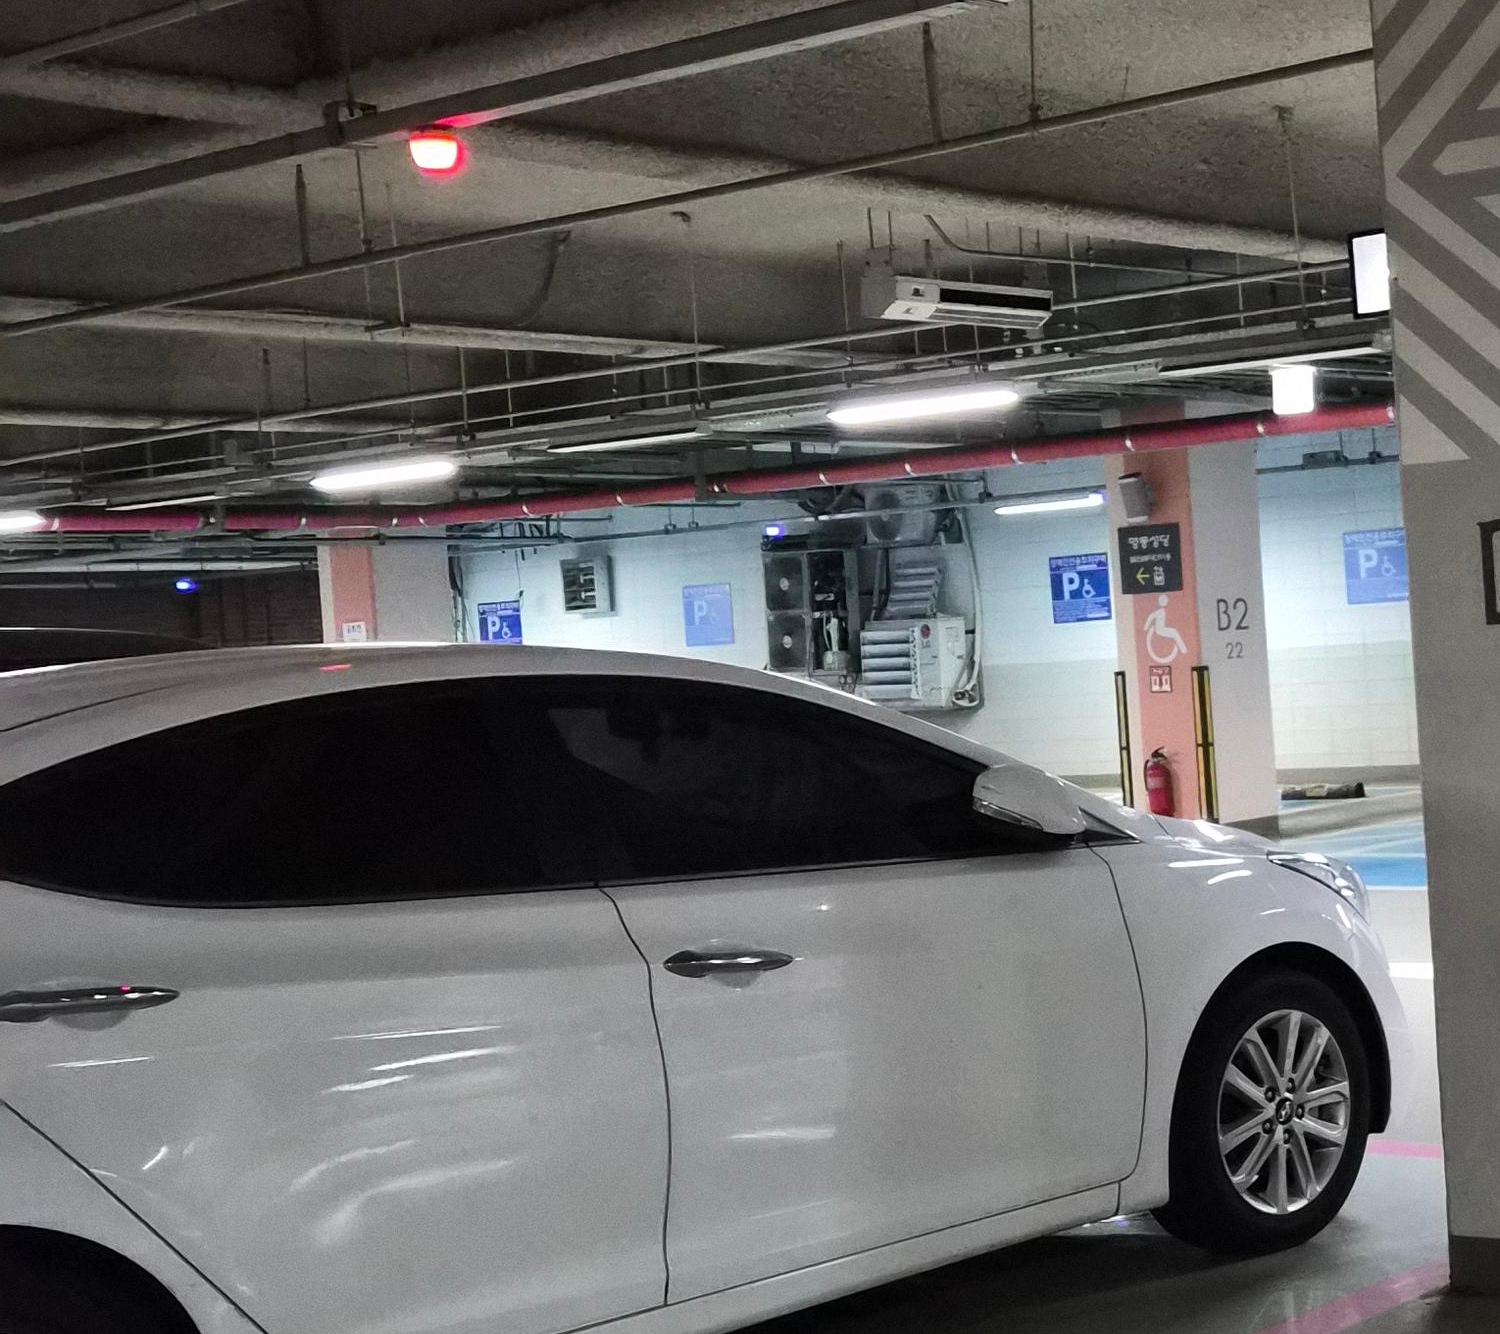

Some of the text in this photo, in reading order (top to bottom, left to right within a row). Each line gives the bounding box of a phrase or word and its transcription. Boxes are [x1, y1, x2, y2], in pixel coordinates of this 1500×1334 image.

[1359, 549, 1378, 579] P
[1062, 572, 1080, 601] P
[693, 601, 707, 625] P
[1217, 598, 1249, 631] B2
[487, 616, 501, 641] P
[1225, 642, 1243, 659] 22
